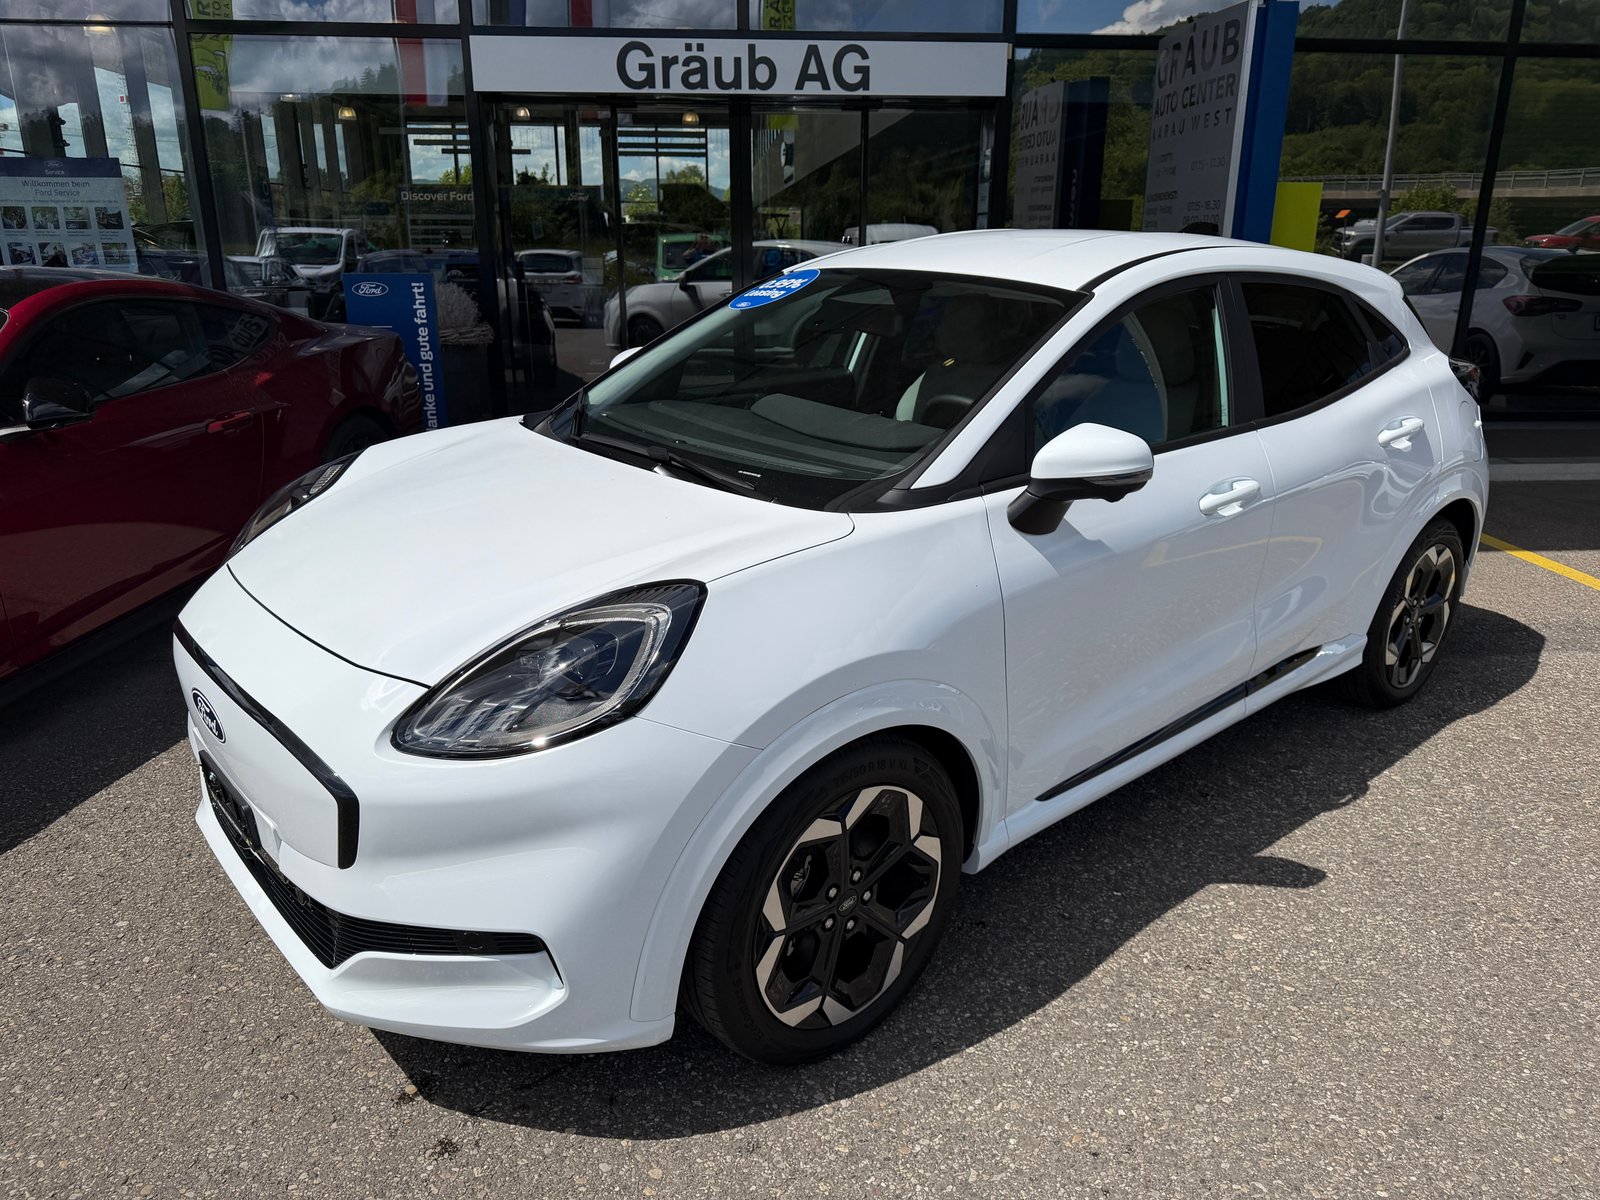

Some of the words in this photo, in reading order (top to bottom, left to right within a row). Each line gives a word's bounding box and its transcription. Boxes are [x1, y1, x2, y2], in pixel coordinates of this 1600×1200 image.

[616, 41, 777, 91] Gräub
[794, 43, 871, 92] AG
[1152, 91, 1179, 119] AUTO
[1182, 73, 1236, 109] CENTER
[1190, 108, 1232, 129] WEST
[21, 180, 70, 188] Willkommen
[71, 180, 90, 188] beim
[34, 189, 52, 197] Ford
[401, 191, 447, 201] Discover
[449, 191, 474, 201] Ford
[411, 282, 428, 324] fahrt!
[417, 327, 434, 361] gute
[419, 363, 436, 391] und
[424, 393, 438, 431] anke
